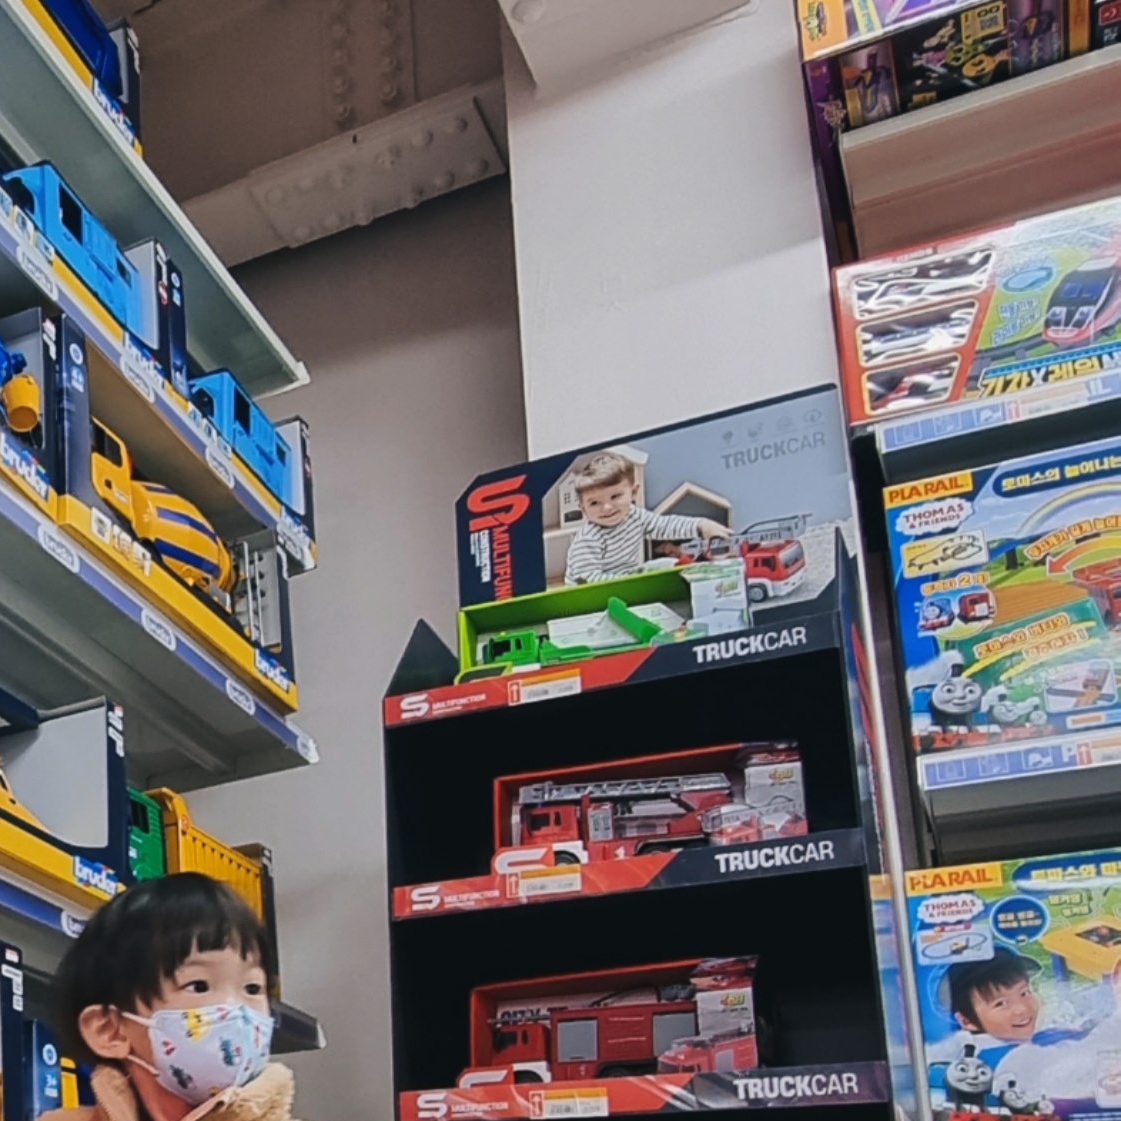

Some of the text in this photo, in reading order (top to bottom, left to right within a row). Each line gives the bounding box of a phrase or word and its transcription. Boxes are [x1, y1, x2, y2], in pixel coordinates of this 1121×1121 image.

[721, 432, 826, 470] TRUCKCAR
[0, 432, 47, 499] bruder
[888, 476, 964, 503] PLARAIL
[903, 503, 964, 523] THOMAS
[918, 514, 961, 528] FRIENDS
[693, 626, 806, 664] TRUCKCAR
[715, 841, 835, 873] TRUCKCAR
[75, 855, 118, 894] bruder
[909, 869, 993, 891] PLARAIL
[923, 899, 976, 912] THOMAS
[937, 907, 974, 918] FRIENDS
[734, 1073, 858, 1101] TRUCKCAR
